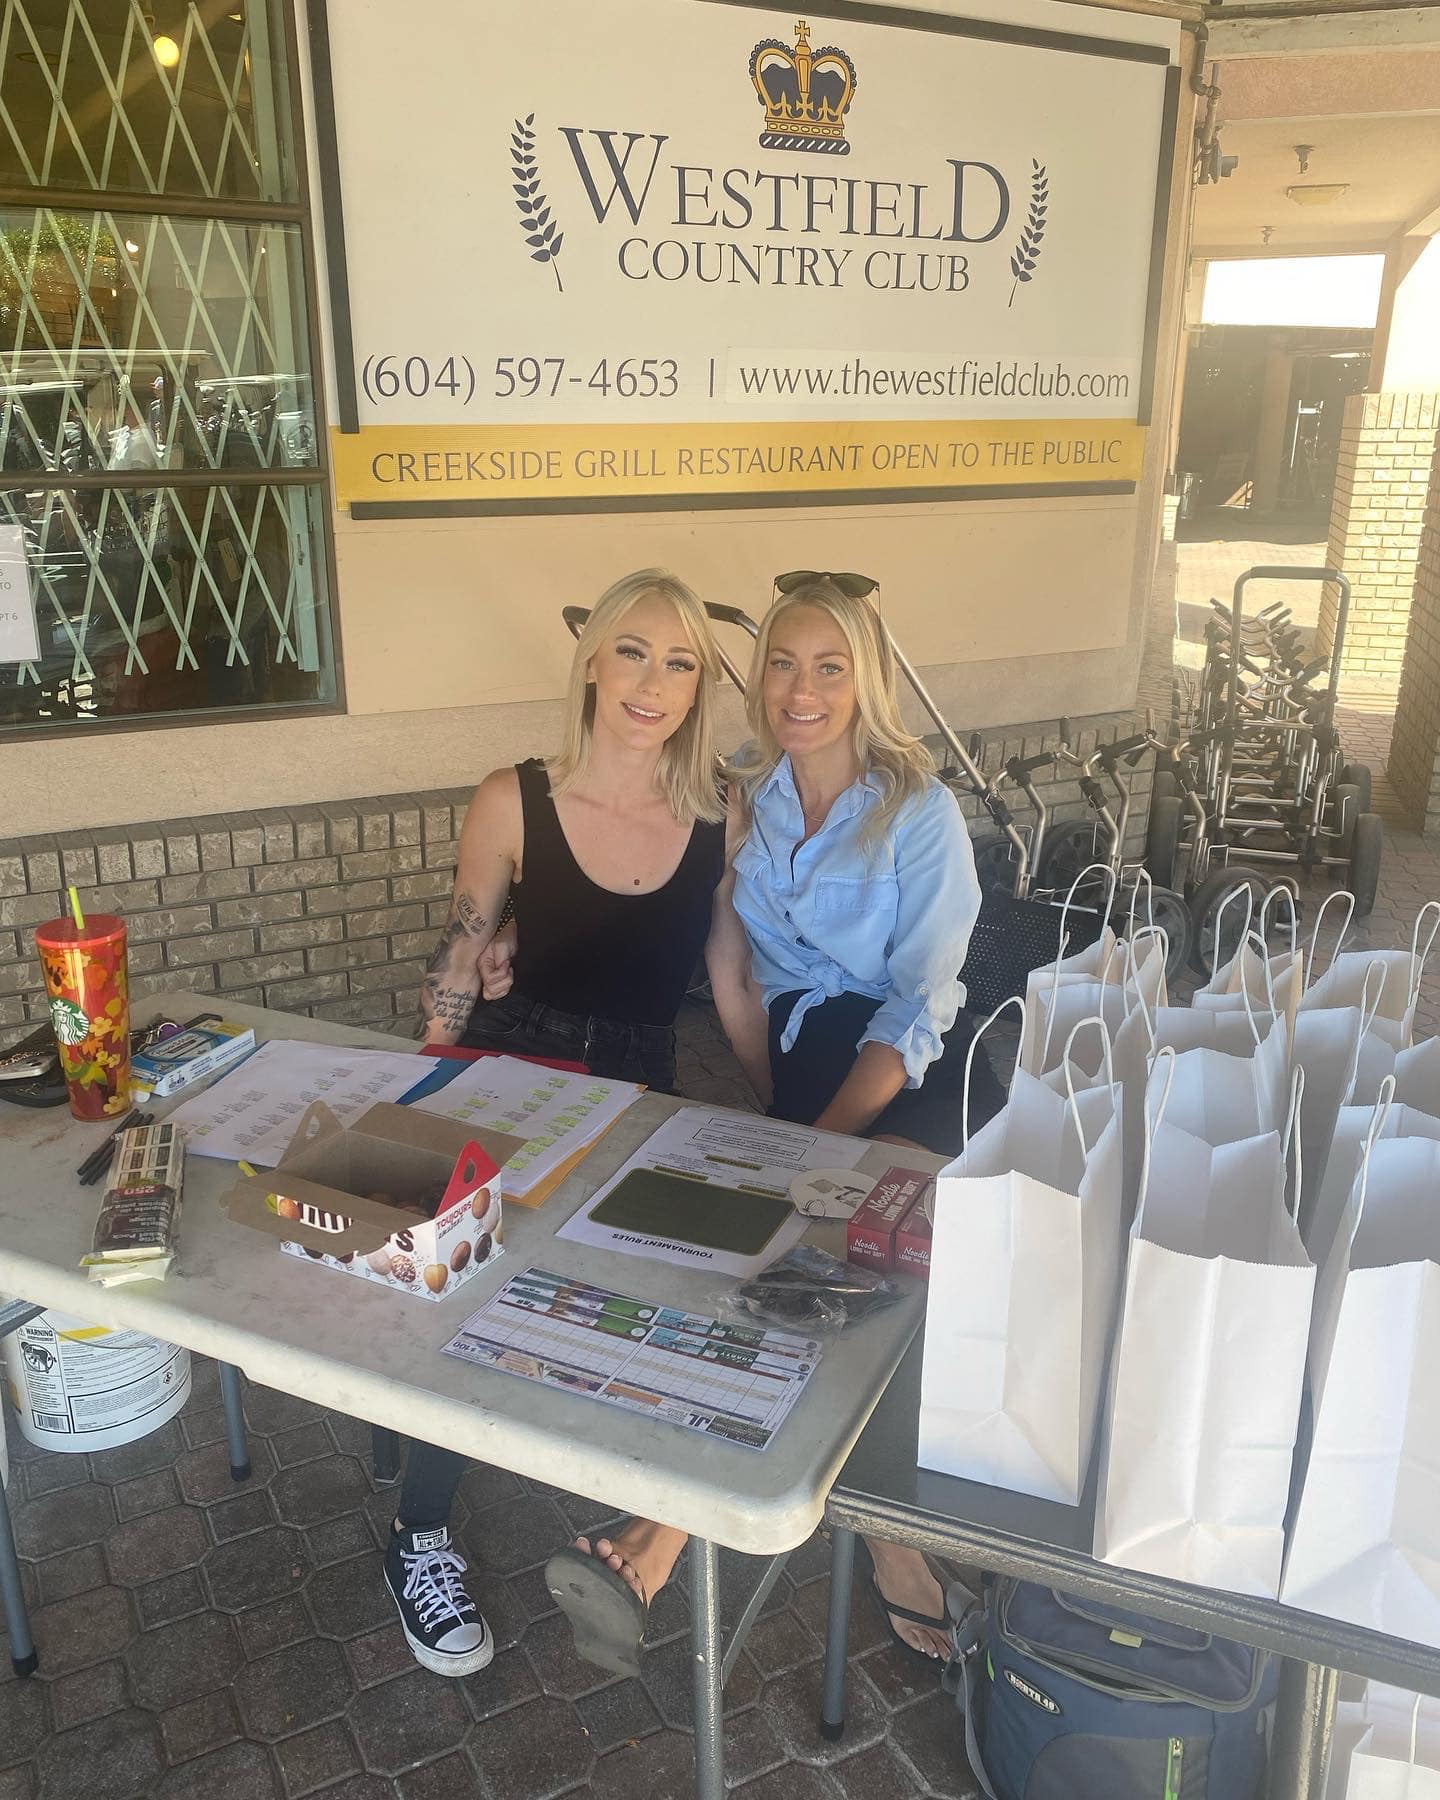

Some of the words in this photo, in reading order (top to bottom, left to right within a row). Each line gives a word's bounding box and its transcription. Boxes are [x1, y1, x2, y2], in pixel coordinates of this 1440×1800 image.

[557, 126, 1010, 244] WESTFIELD
[617, 237, 854, 289] COUNTRY
[863, 250, 971, 292] CLUB
[361, 354, 477, 406] (604)
[494, 356, 680, 398] 597-4653
[739, 357, 1130, 398] www.thewestfieldclub.com
[371, 451, 564, 484] CREEKSIDE
[574, 449, 667, 479] GRILL
[677, 444, 865, 476] RESTAURANT
[871, 443, 940, 470] OPEN
[948, 442, 980, 467] TO
[987, 441, 1035, 466] THE
[1041, 439, 1123, 465] PUBLIC
[867, 1183, 901, 1213] Noodle
[435, 1201, 472, 1230] TOUJOURS
[611, 1233, 641, 1244] RULES
[643, 1239, 713, 1259] TOURNAMENT
[854, 1238, 880, 1251] Noodle
[25, 1327, 53, 1337] WARNING
